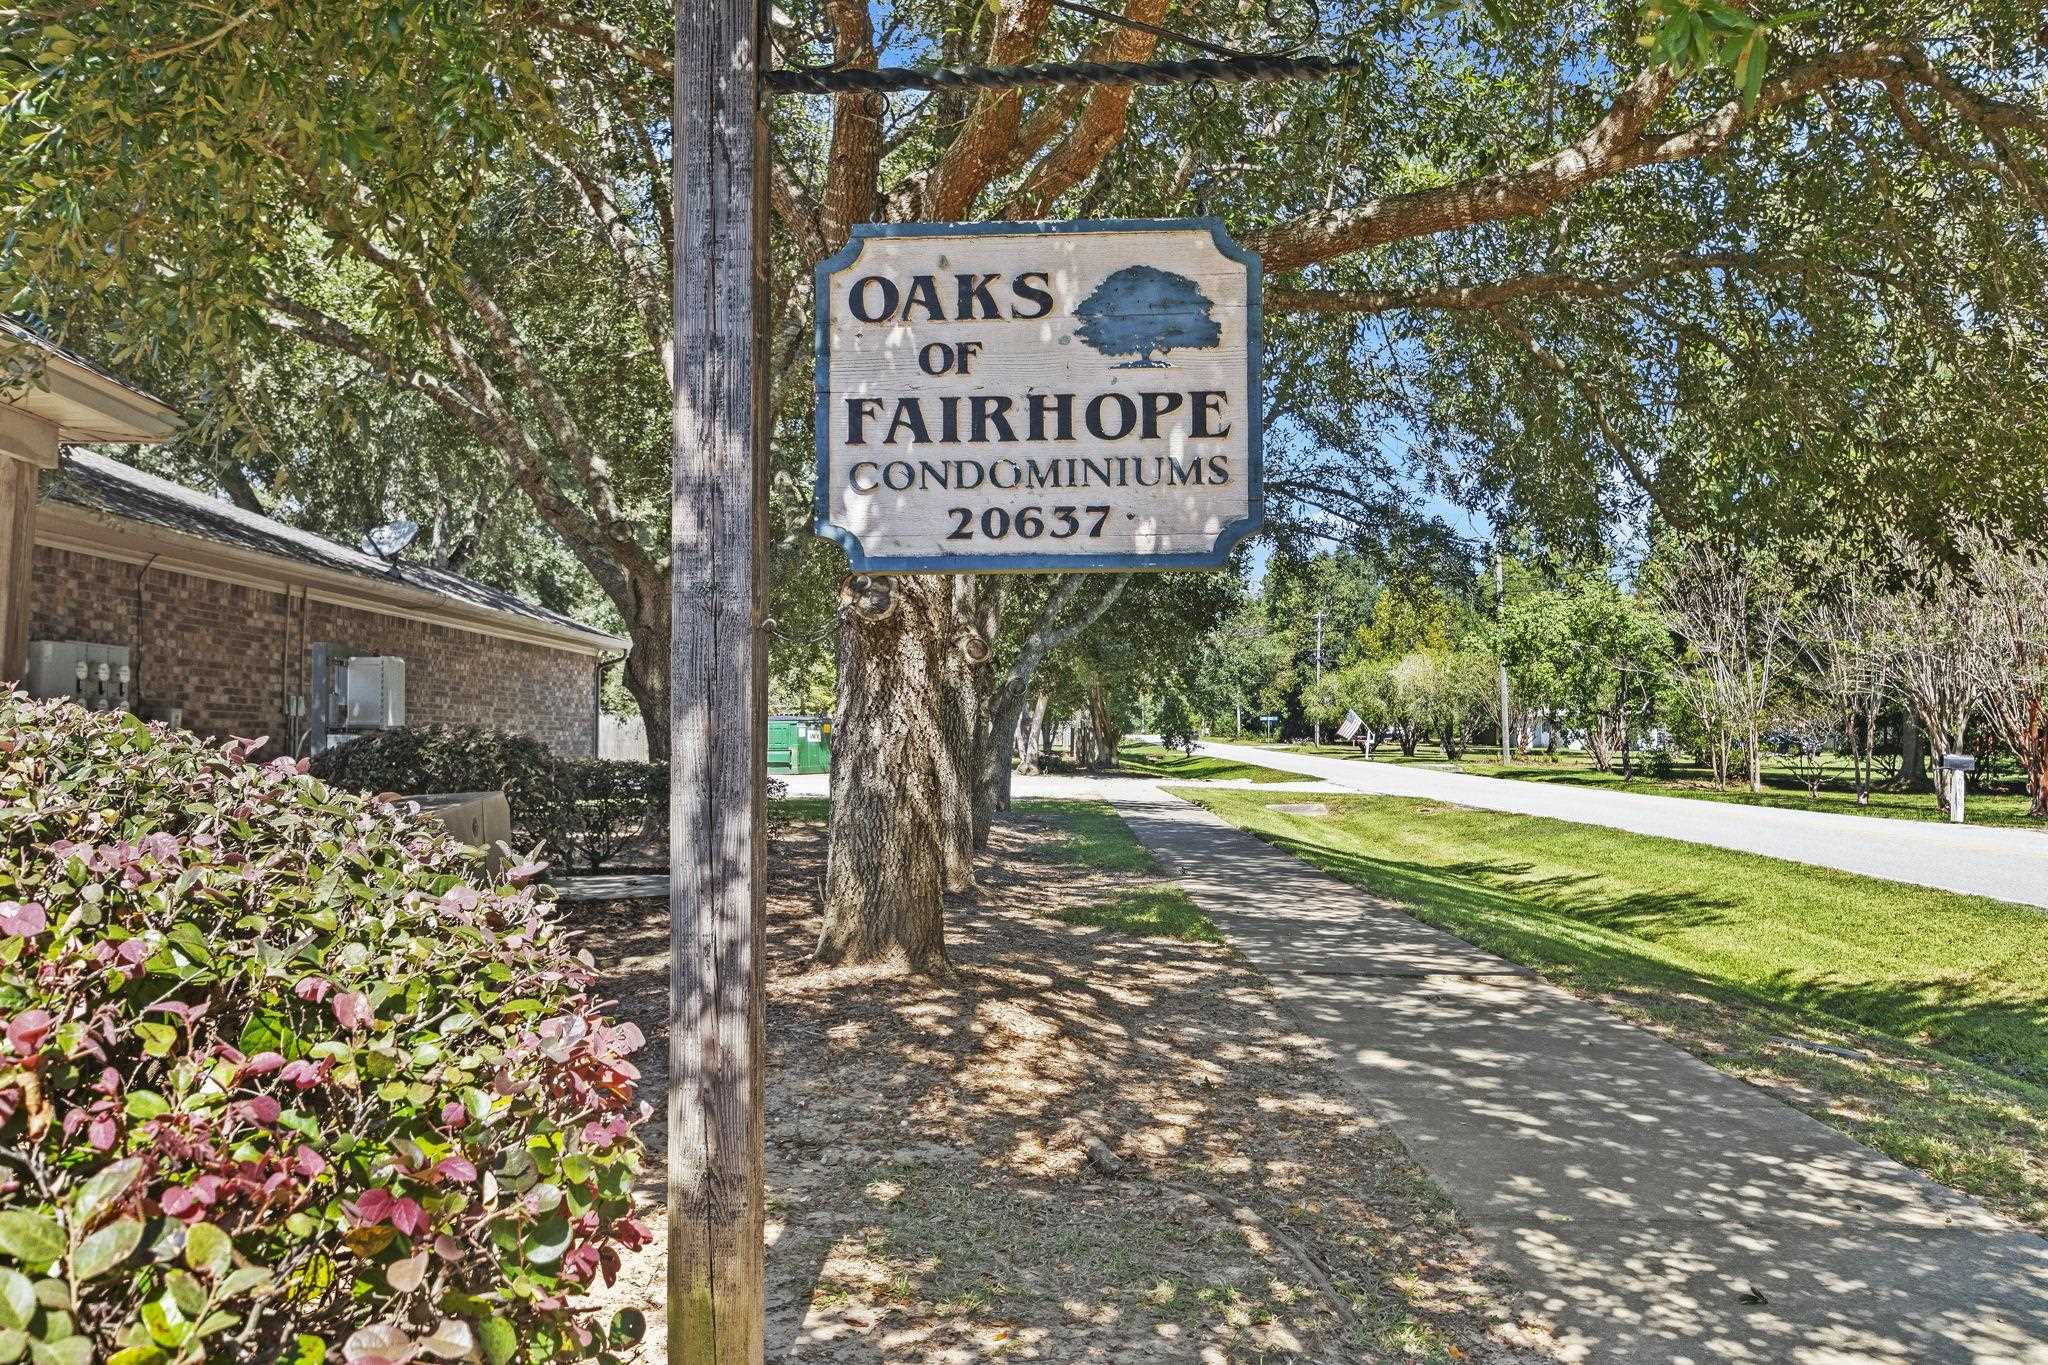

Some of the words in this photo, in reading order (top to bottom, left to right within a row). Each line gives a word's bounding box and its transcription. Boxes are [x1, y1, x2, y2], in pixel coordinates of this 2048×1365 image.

[848, 273, 1054, 323] OAKS
[919, 341, 983, 375] OF
[844, 390, 1231, 445] FAIRHOPE
[849, 455, 1230, 495] CONDOMINIUMS
[947, 505, 1111, 540] 20637
